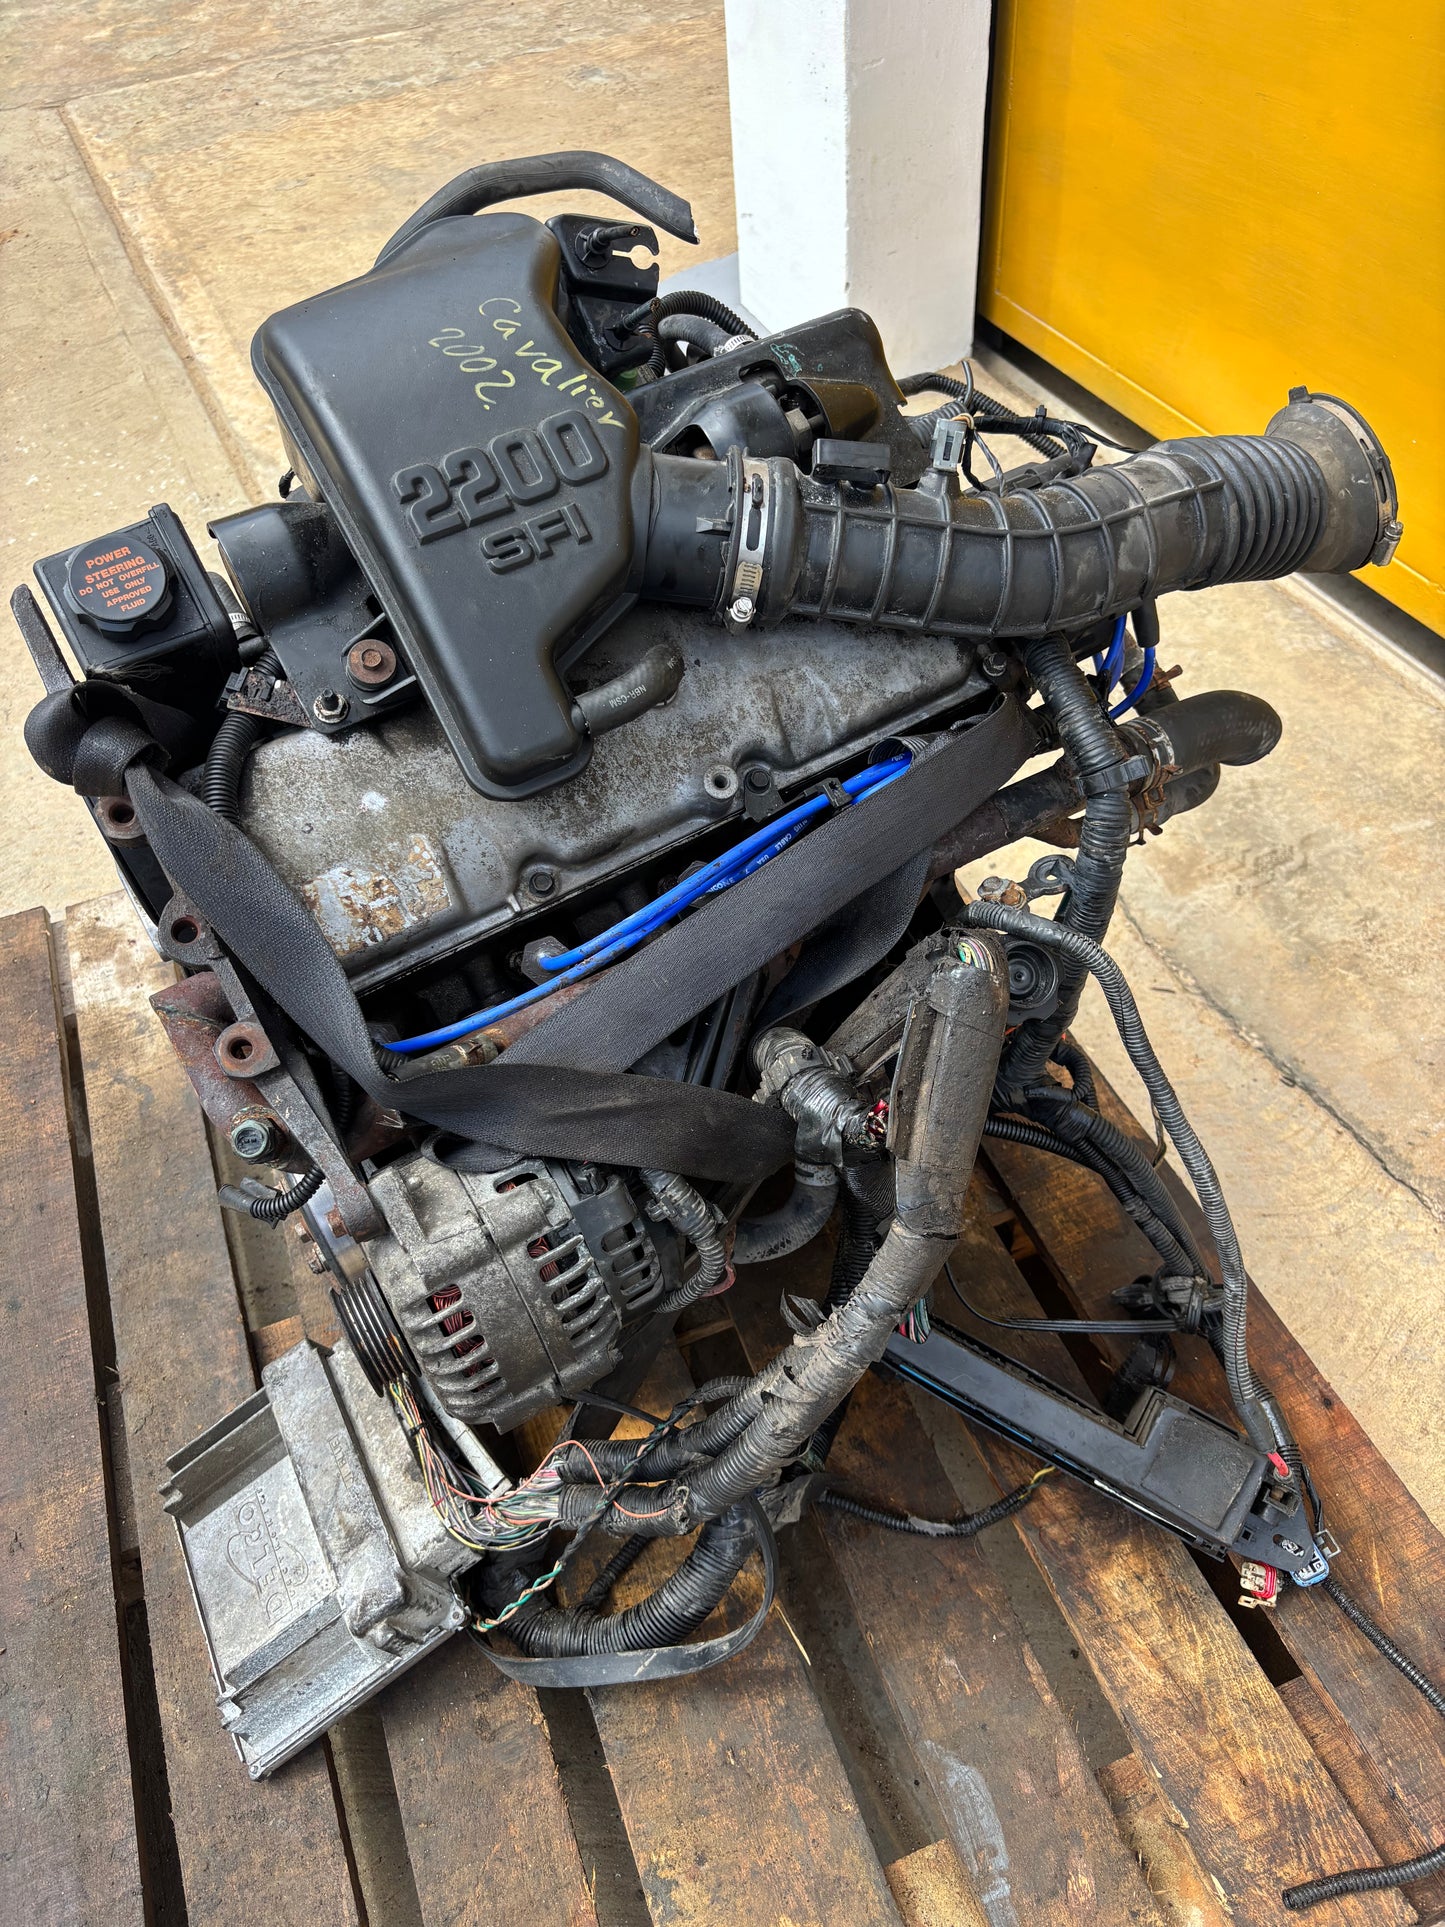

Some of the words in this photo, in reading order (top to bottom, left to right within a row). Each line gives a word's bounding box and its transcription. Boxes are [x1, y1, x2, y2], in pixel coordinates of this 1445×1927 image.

[479, 297, 626, 429] Cavalier
[391, 409, 610, 546] 2200
[480, 501, 593, 575] SFI
[85, 546, 132, 569] POWER
[85, 556, 146, 584] STEERING
[79, 586, 93, 596] DO
[95, 578, 115, 590] NOT
[118, 562, 160, 581] OVERFILL
[101, 587, 120, 598] USE
[124, 576, 146, 589] ONLY
[106, 585, 153, 608] APPROVED
[120, 598, 146, 612] FLUID
[608, 684, 648, 709] NBR-CSM
[774, 833, 792, 852] CABLE
[756, 854, 770, 865] USA
[238, 1501, 283, 1621] DELCO
